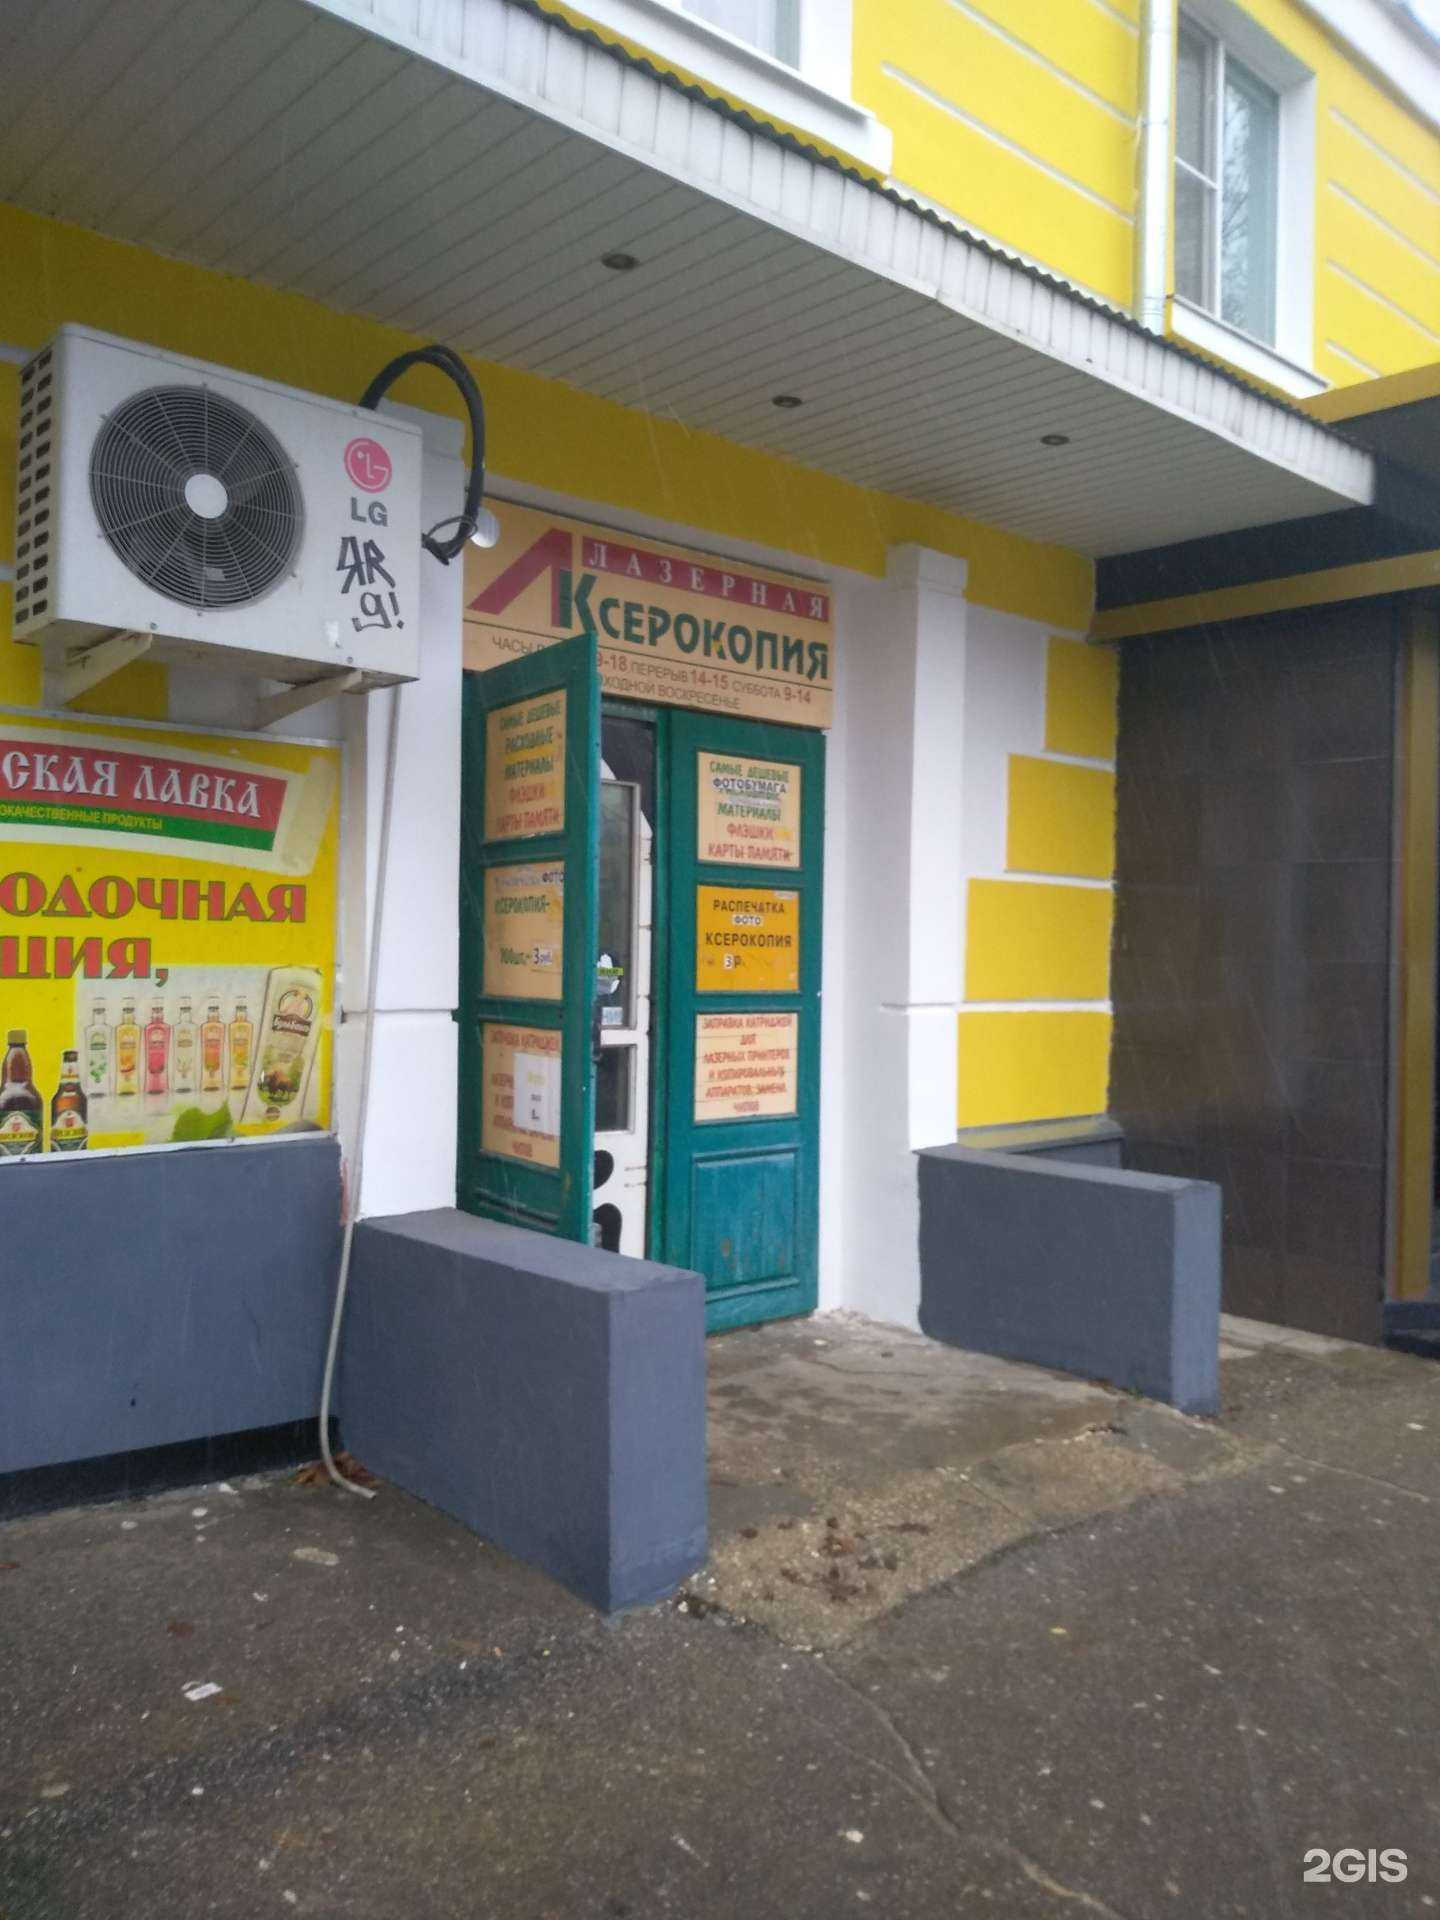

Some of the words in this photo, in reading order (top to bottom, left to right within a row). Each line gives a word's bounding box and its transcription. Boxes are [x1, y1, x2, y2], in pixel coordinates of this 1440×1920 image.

[351, 497, 388, 527] LG
[588, 541, 825, 619] ЛАЗЕРНАЯ
[630, 661, 689, 683] ПЕРЕРЫВ
[690, 669, 730, 689] 14-15
[731, 680, 782, 699] СУББОТА
[782, 686, 812, 705] 9-14
[657, 684, 742, 710] ВОСКРЕСЕНЬЕ
[1, 750, 120, 799] СКАЯ
[132, 764, 262, 819] ЛАВКА
[713, 777, 787, 793] ФОТОБУМАГА
[716, 801, 782, 821] МАТЕРИАЛЫ
[103, 812, 163, 831] ПРОДУКТЫ
[708, 842, 745, 859] КАРТЫ
[747, 845, 791, 862] ПАМЯТИ
[0, 871, 307, 923] ОДОЧНАЯ
[713, 899, 785, 914] РАСПЕЧАТКА
[733, 915, 762, 925] ФОТО
[705, 931, 792, 948] КСЕРОКОПИЯ
